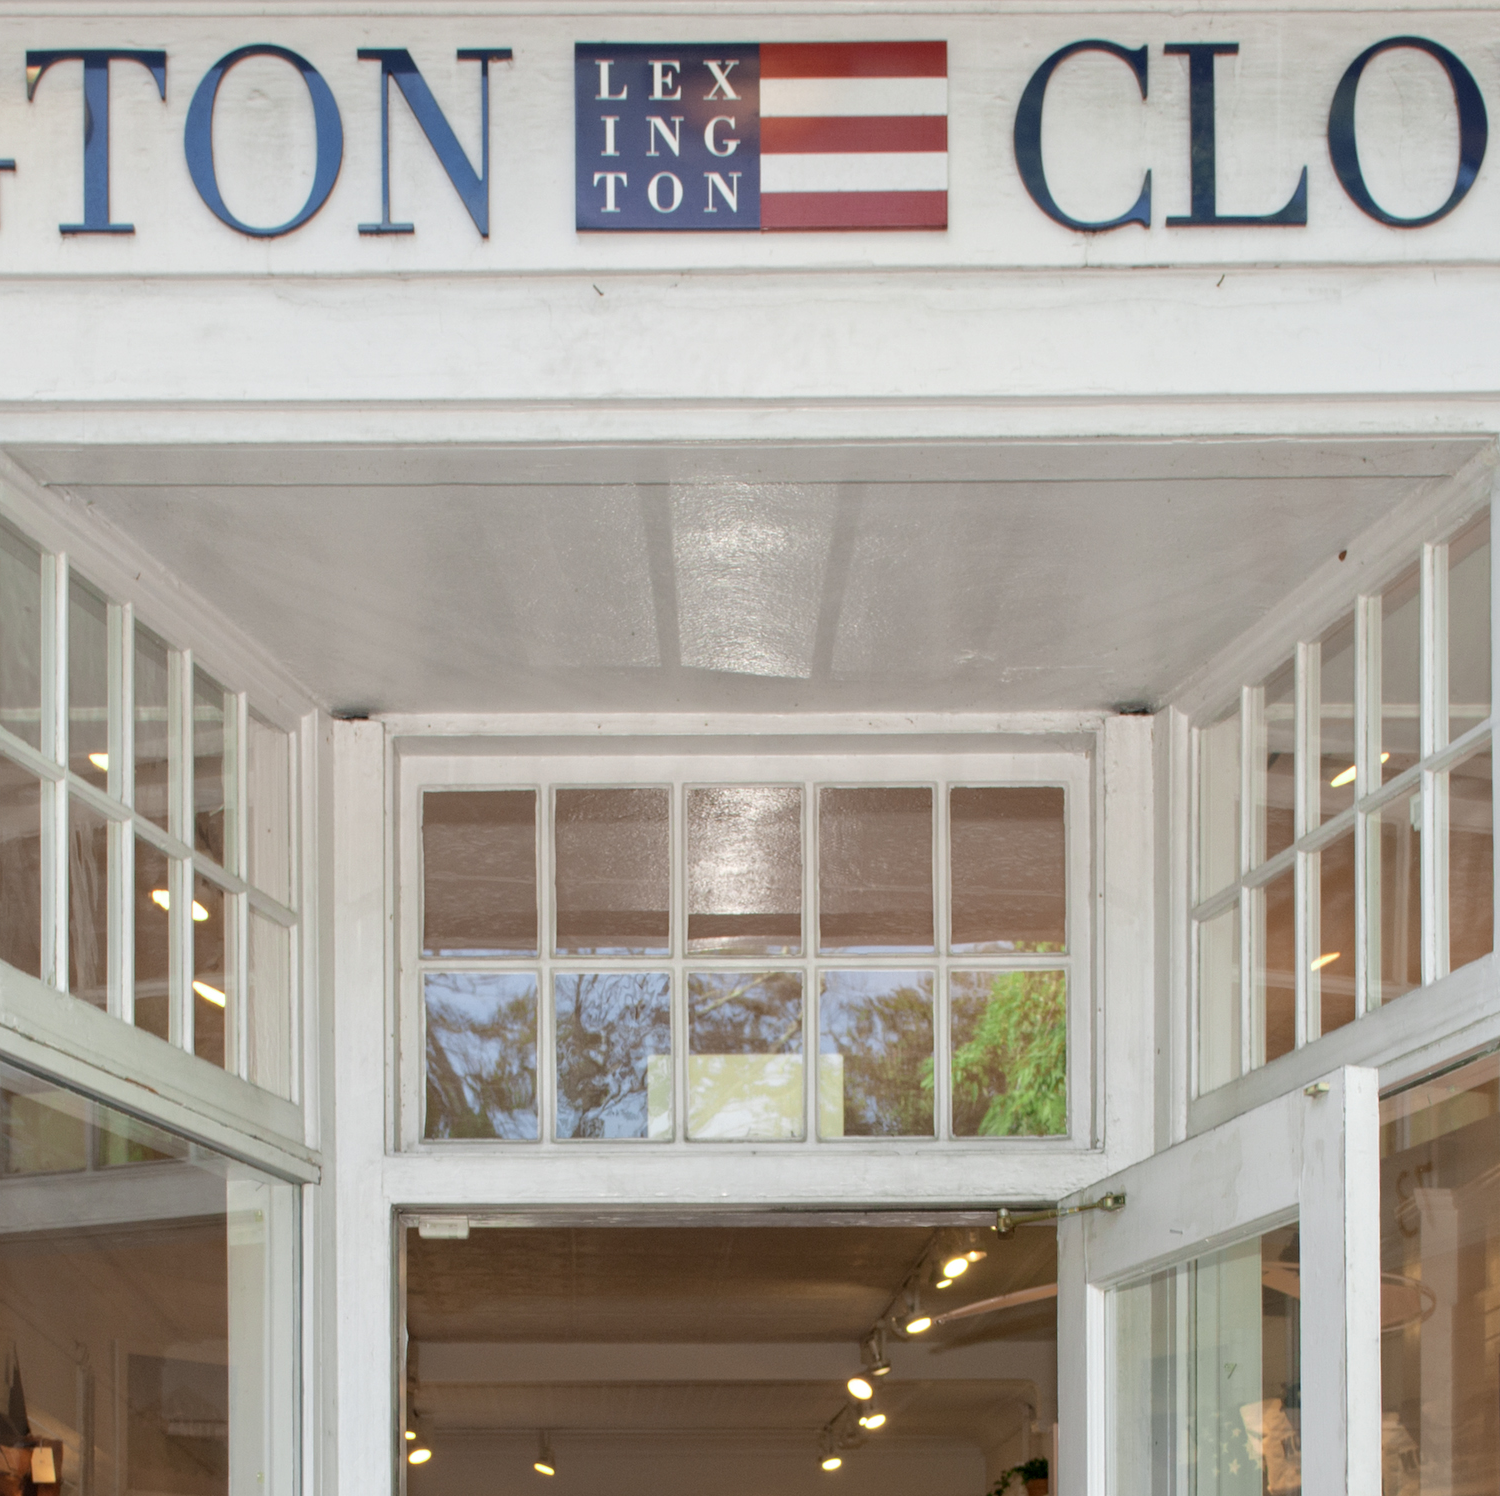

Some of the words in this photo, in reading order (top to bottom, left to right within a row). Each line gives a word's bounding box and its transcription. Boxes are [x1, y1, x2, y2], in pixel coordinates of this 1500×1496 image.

[595, 60, 742, 100] LEX
[601, 115, 740, 156] ING
[593, 171, 742, 213] TON
